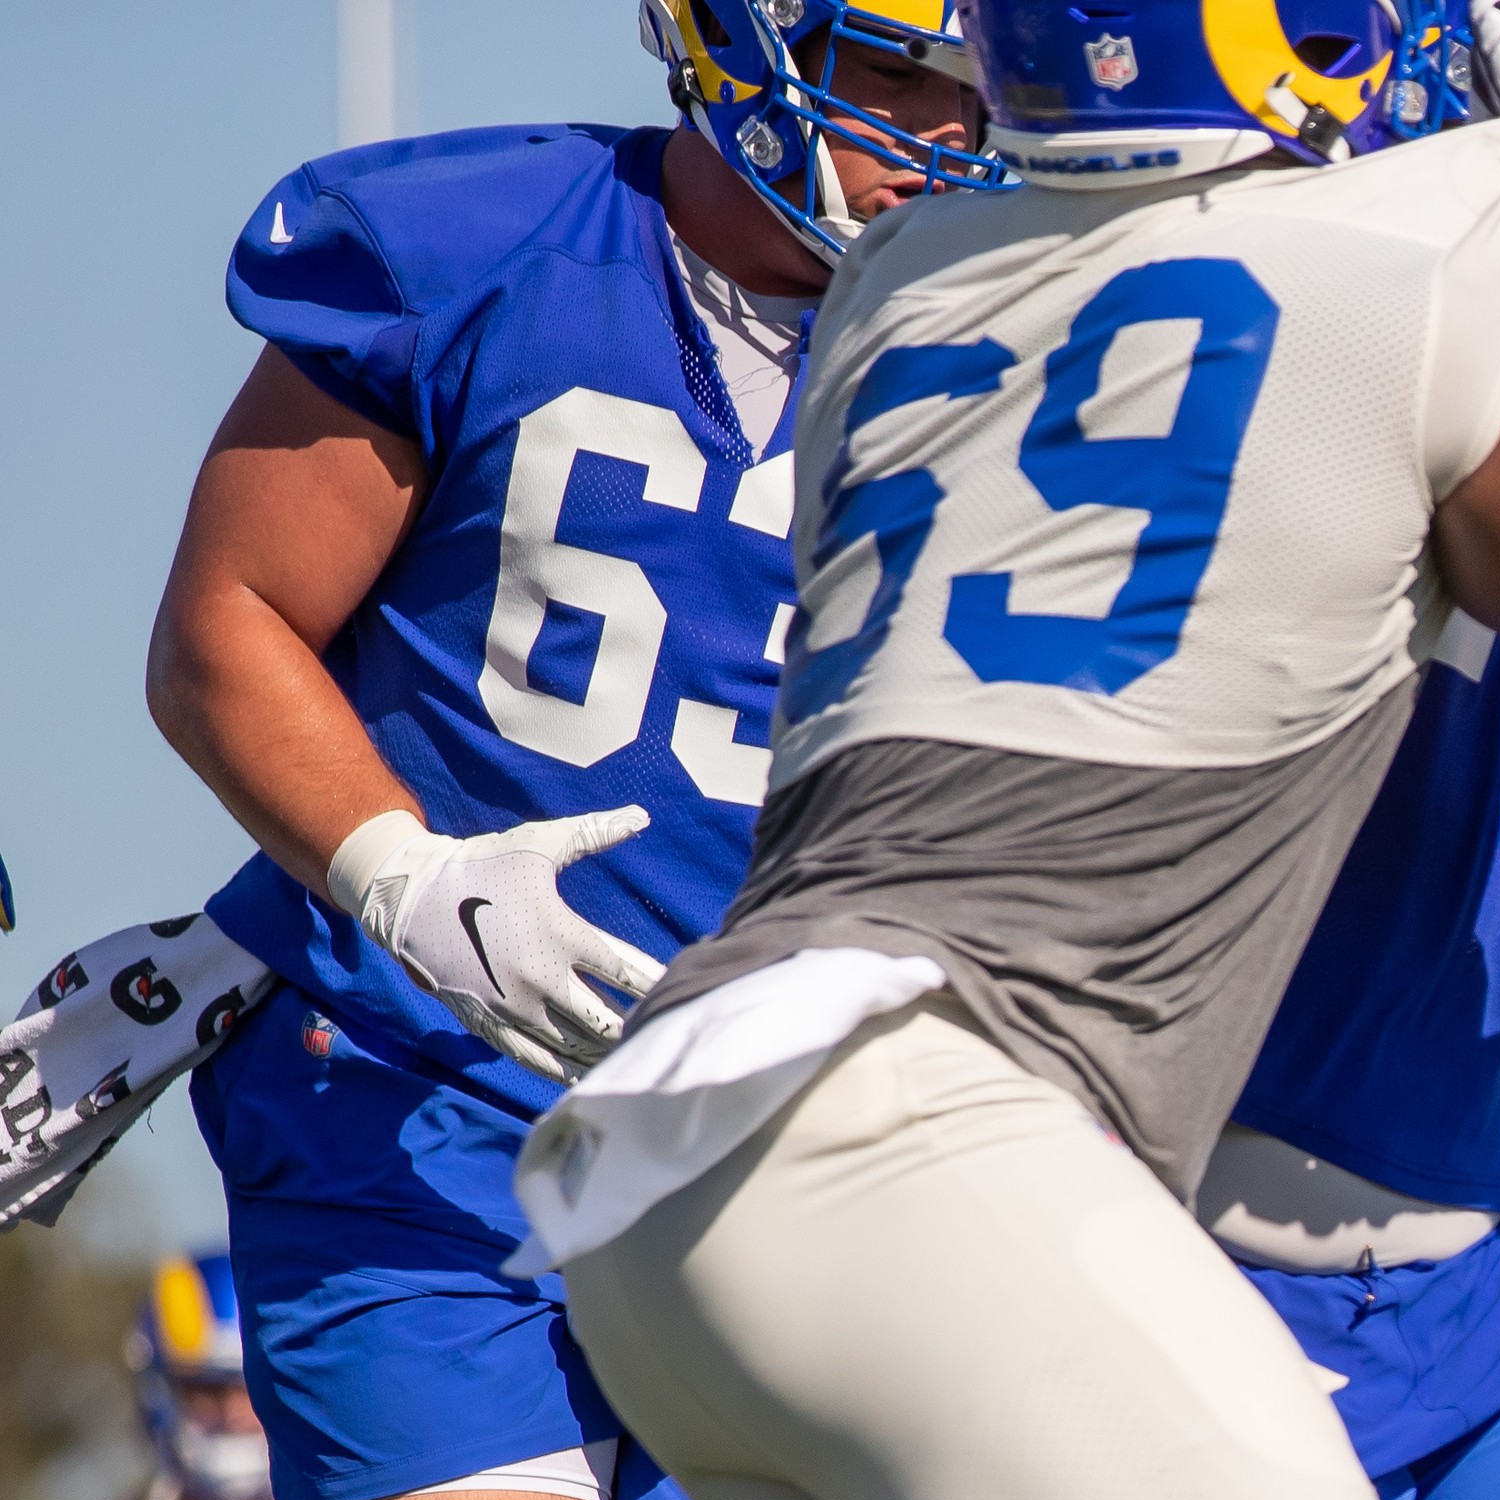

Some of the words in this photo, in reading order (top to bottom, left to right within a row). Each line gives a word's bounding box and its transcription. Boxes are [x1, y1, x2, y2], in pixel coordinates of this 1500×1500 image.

[478, 385, 796, 808] 63
[781, 257, 1281, 726] 69
[110, 955, 183, 1026] G
